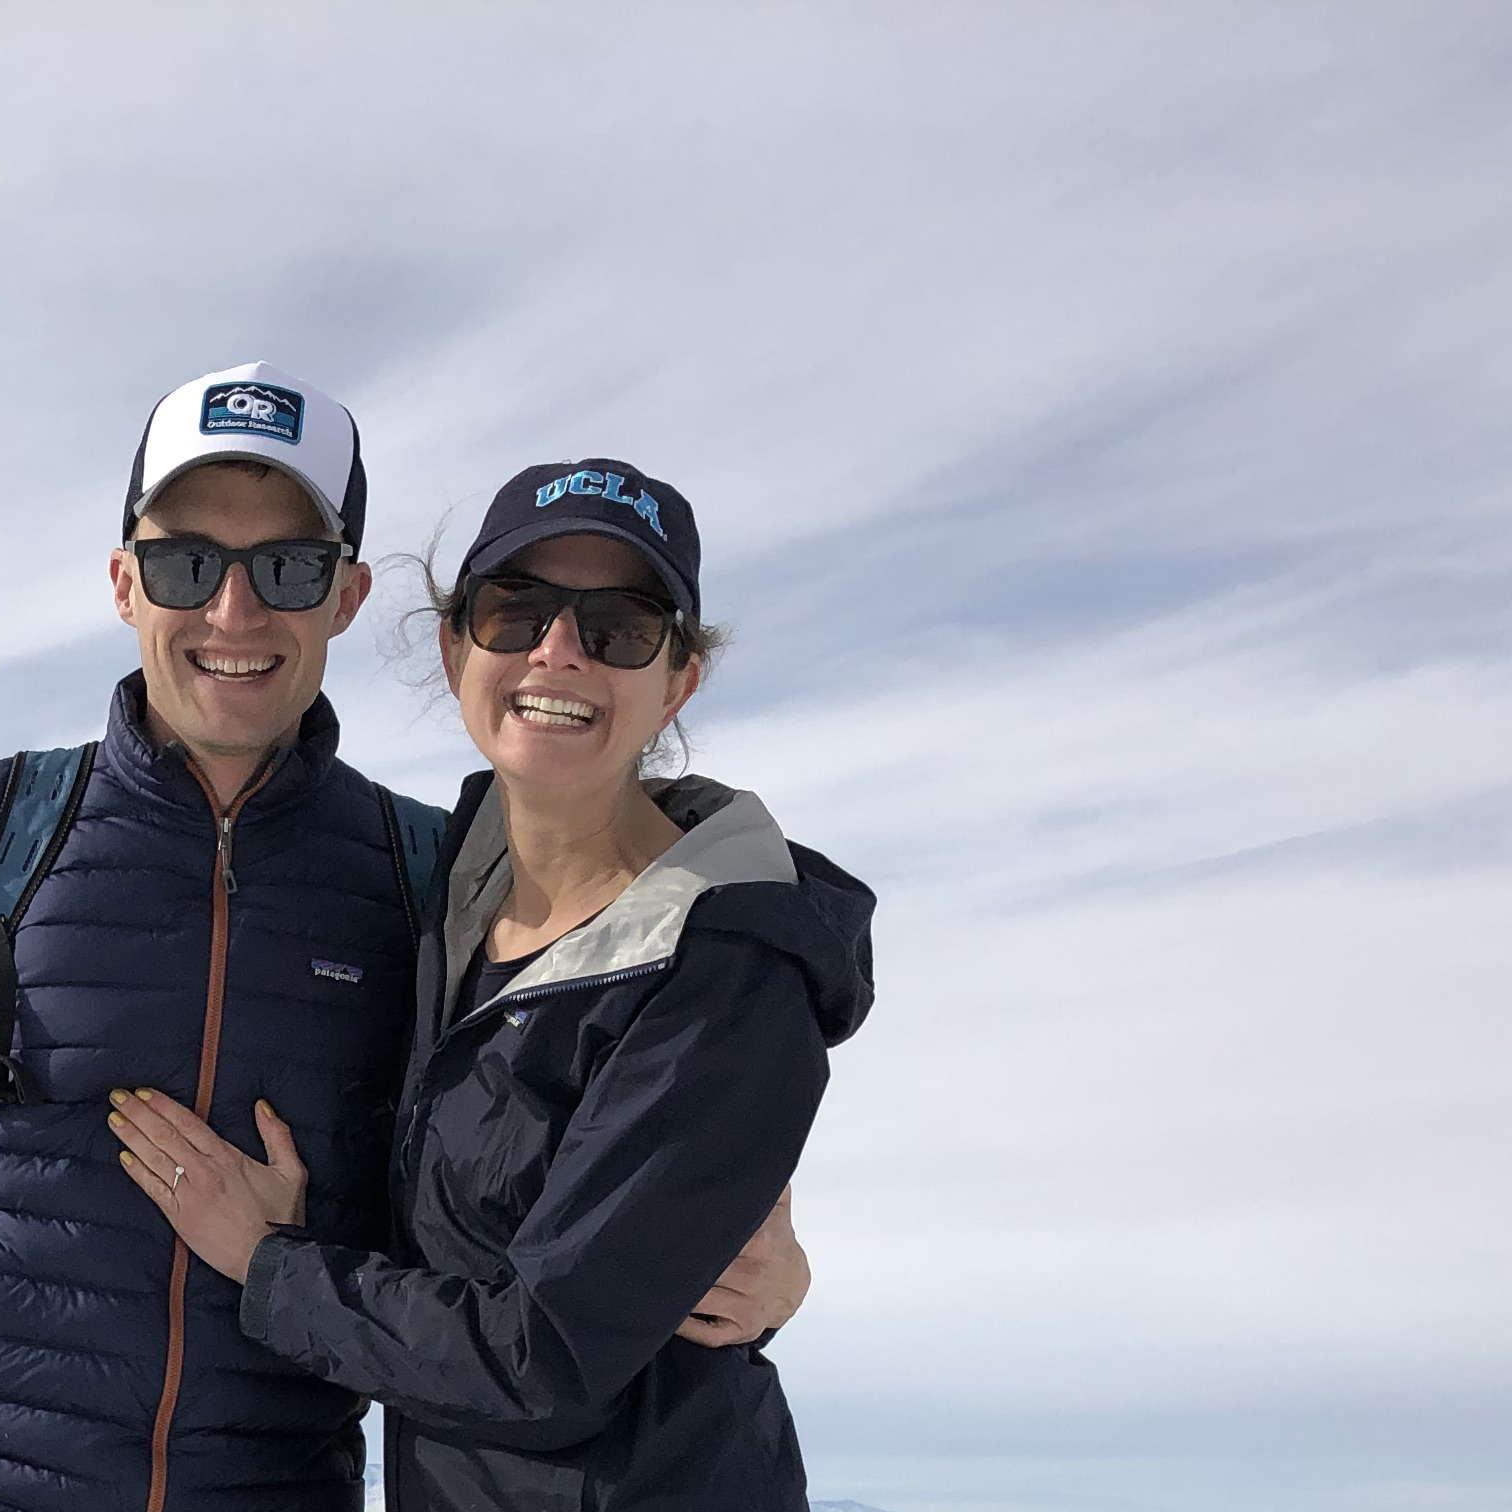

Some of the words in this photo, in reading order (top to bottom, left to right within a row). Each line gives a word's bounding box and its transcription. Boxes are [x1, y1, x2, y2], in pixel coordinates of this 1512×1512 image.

[227, 393, 276, 422] OR
[207, 420, 248, 429] Outdoor
[248, 421, 292, 437] Research
[536, 470, 664, 537] UCLA
[314, 968, 358, 983] patagonia
